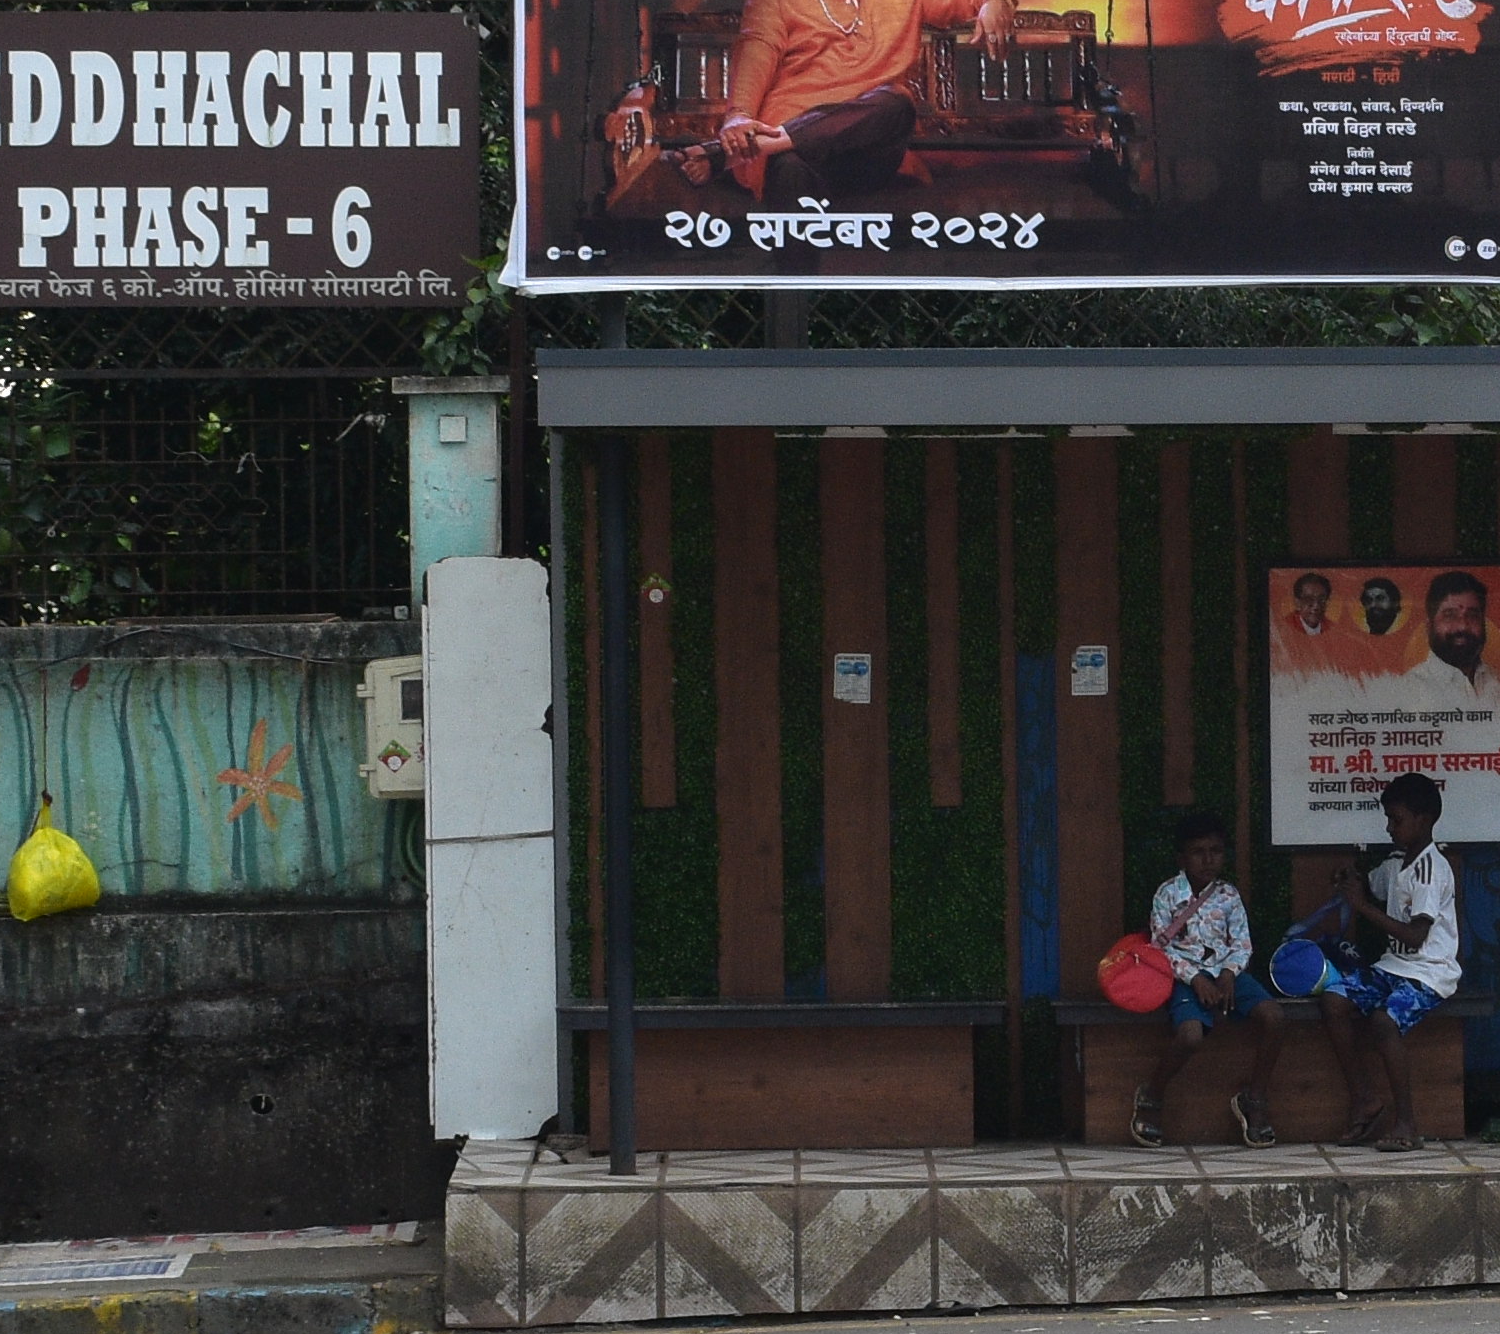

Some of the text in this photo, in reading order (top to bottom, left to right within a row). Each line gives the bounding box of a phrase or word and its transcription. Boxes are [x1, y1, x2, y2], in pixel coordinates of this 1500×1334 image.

[1321, 68, 1356, 83] मराठी
[1373, 68, 1401, 85] हिंदी
[1302, 117, 1339, 136] प्रविण
[1386, 117, 1417, 135] तरडे
[1309, 161, 1413, 178] मंगेश जीवन देसाई
[1309, 178, 1337, 193] उमेश
[1341, 182, 1373, 197] कुमार
[17, 186, 270, 268] PHASE
[331, 185, 372, 269] 6
[664, 196, 1046, 251] २७ सप्टेंबर २०२४
[48, 270, 94, 299] फेज
[103, 278, 116, 300] ६
[311, 268, 412, 299] सोसायटी
[418, 268, 457, 298] लि.
[1309, 713, 1335, 725] सदर
[1336, 709, 1369, 724] ज्येष्ठ
[1372, 709, 1416, 724] नागरिक
[1466, 710, 1493, 722] काम
[1309, 727, 1444, 748] स्थानिक आमदार
[1309, 755, 1339, 774] मा.
[1344, 749, 1377, 774] श्री.
[1382, 753, 1438, 772] प्रताप
[1308, 778, 1347, 794] यांच्या
[1308, 800, 1352, 811] करण्यात
